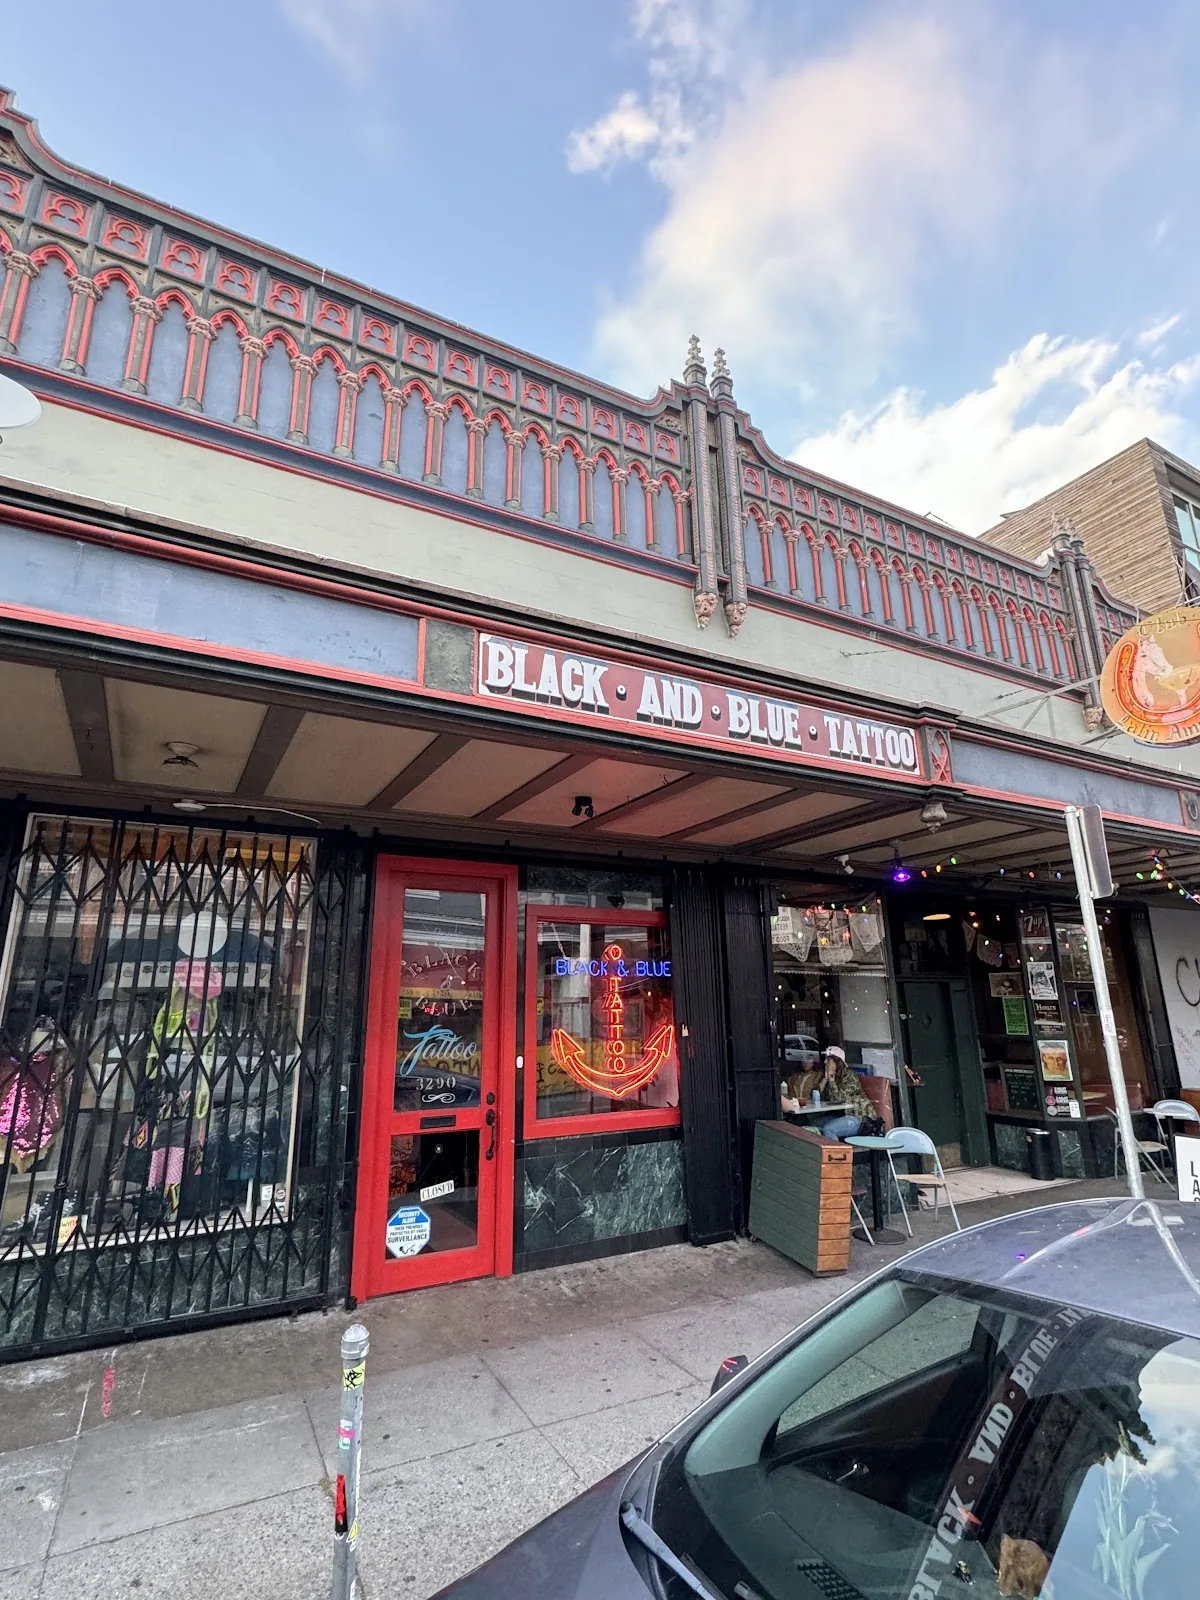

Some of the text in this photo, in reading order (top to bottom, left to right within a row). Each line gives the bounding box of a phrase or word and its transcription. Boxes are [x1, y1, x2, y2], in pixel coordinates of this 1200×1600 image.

[1139, 613, 1187, 637] Club
[485, 640, 916, 769] BLACK AND BLUE TATTOO
[1116, 714, 1160, 741] Latin
[407, 951, 481, 979] BLACK
[555, 958, 672, 978] BLACK & BLUE
[414, 995, 474, 1017] BLUE
[609, 976, 626, 1073] TATTOO
[400, 1024, 478, 1078] Tattoo
[415, 1076, 457, 1091] 3290
[421, 1181, 454, 1200] CLOSED
[387, 1234, 428, 1244] SURVEILLANCE
